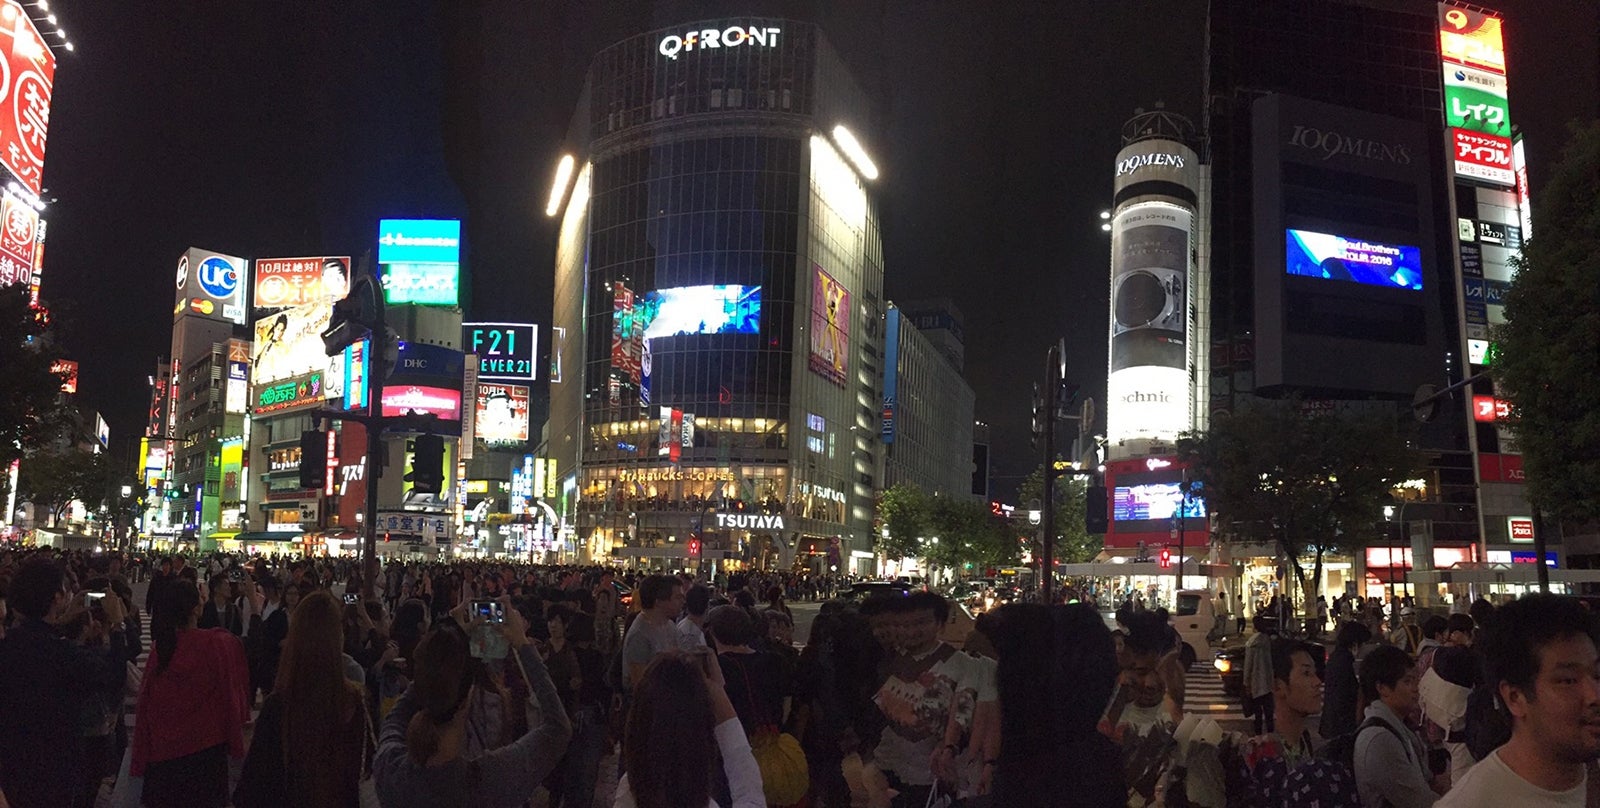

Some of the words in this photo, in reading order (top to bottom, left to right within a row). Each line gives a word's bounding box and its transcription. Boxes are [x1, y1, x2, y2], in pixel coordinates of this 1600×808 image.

[659, 26, 780, 60] QFRONT
[1452, 97, 1503, 123] レイク
[1288, 126, 1342, 160] 109
[1341, 137, 1412, 164] MEN'S
[1457, 142, 1510, 164] アイフル
[1116, 155, 1140, 176] 109
[1139, 153, 1184, 168] MEN'S
[203, 264, 238, 290] UC
[260, 262, 319, 275] 10月は絶対!
[404, 359, 428, 373] DHC
[619, 470, 684, 482] STARBUCKS
[693, 471, 735, 482] COFFEE
[716, 513, 785, 530] TSUTAYA
